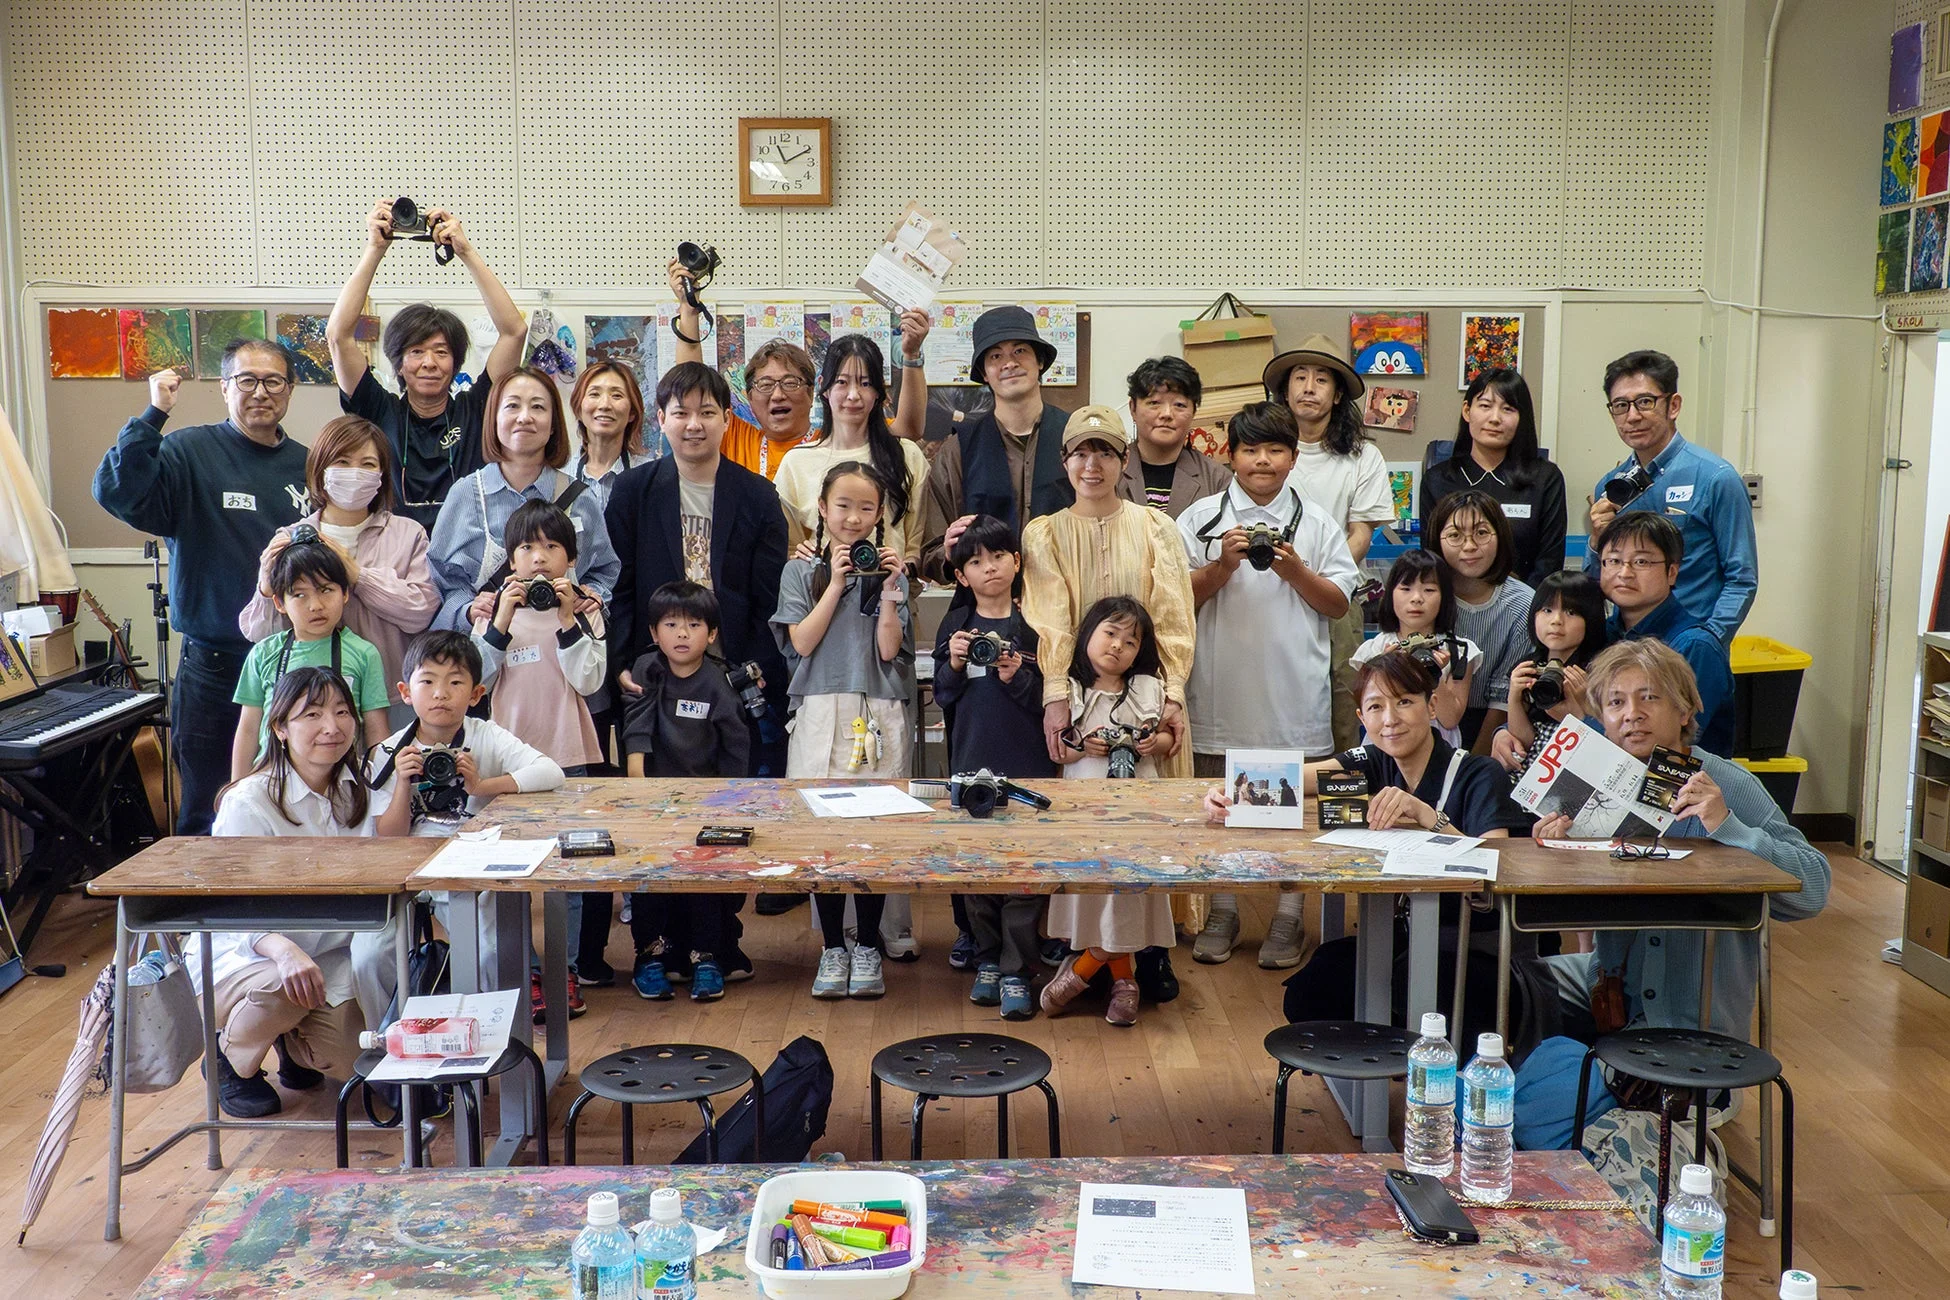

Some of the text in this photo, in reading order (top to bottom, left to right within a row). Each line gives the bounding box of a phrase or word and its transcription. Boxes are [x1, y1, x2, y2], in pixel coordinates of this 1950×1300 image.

[769, 136, 776, 145] 11
[780, 133, 791, 142] 12
[758, 145, 770, 155] 10
[807, 157, 815, 167] 3
[803, 170, 811, 180] 4
[770, 180, 778, 189] 7
[781, 182, 790, 191] 6
[794, 180, 802, 189] 5
[1538, 727, 1580, 784] JPS
[1657, 764, 1691, 779] SUNEAST
[1327, 784, 1359, 792] SUNEAST
